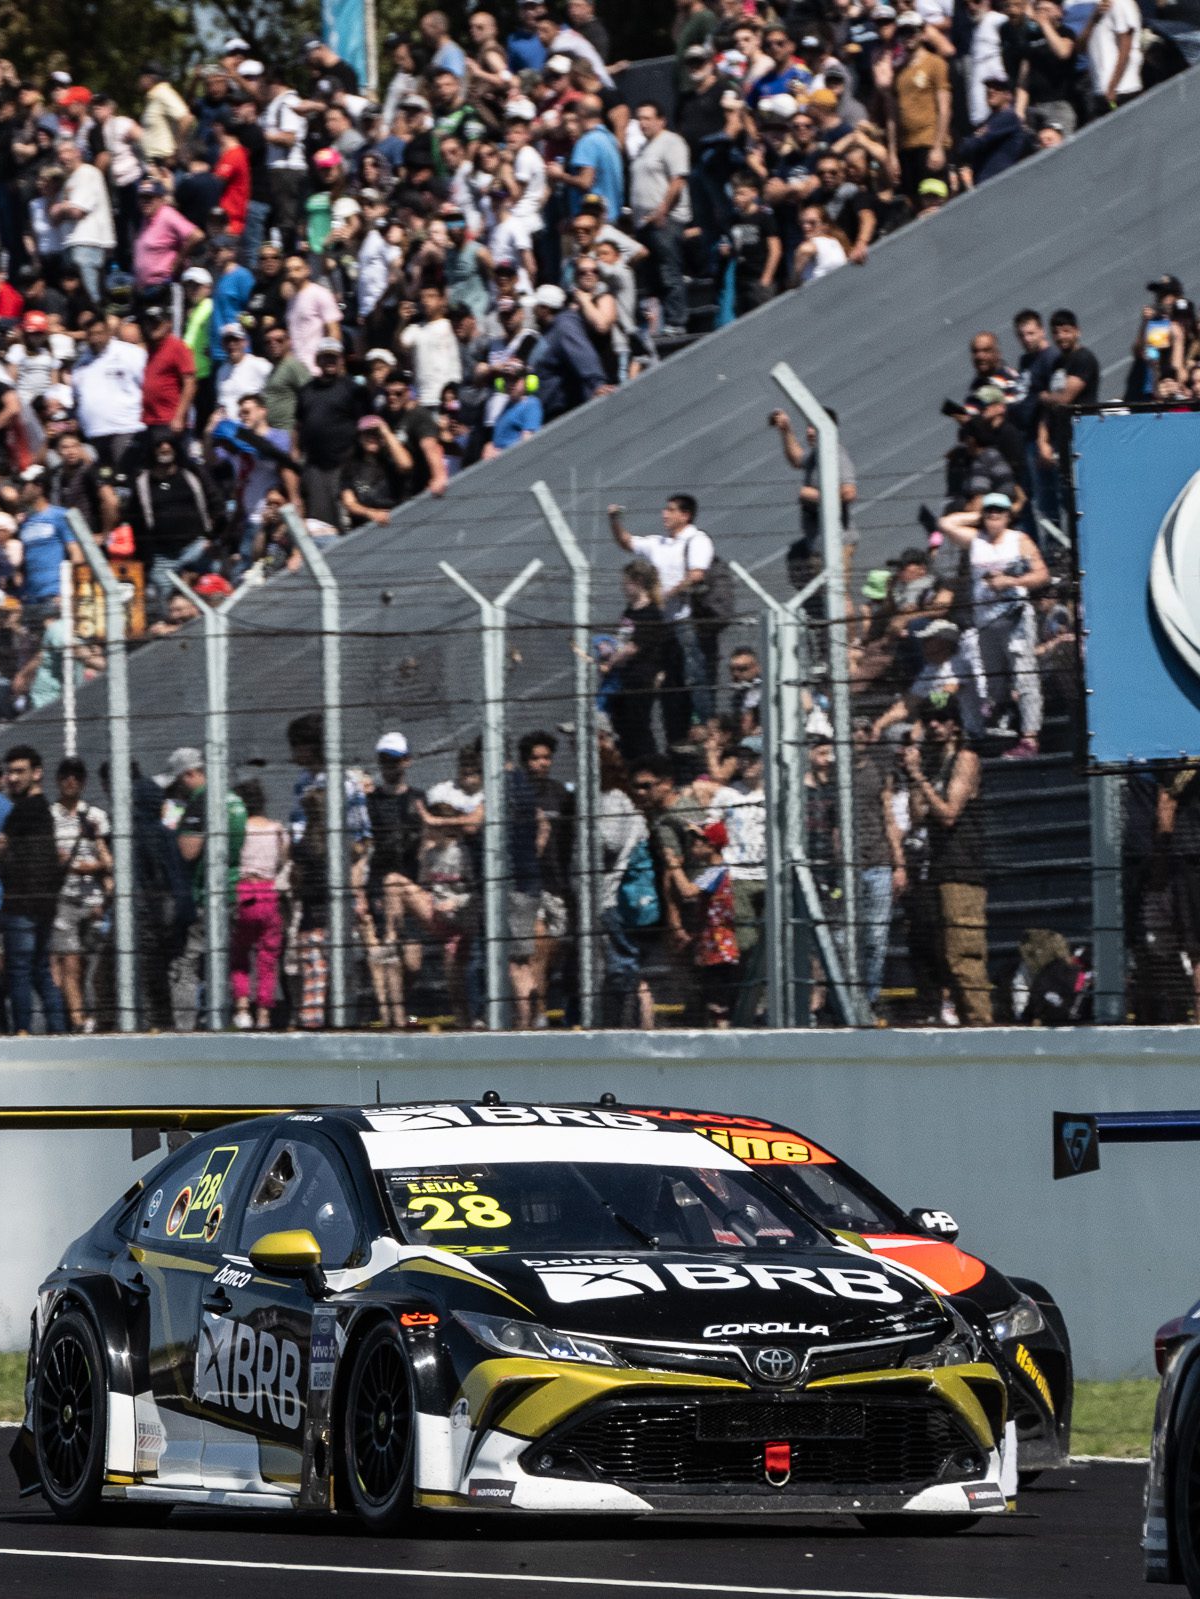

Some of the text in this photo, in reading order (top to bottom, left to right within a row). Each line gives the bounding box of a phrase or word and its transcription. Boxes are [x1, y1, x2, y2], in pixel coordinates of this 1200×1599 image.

[470, 1106, 660, 1131] BRB
[694, 1127, 810, 1162] ine
[190, 1173, 223, 1211] 28
[406, 1180, 479, 1194] E.ELIAS
[407, 1194, 512, 1231] 28
[212, 1263, 252, 1289] banco
[520, 1257, 640, 1268] banco
[661, 1262, 904, 1304] BRB
[702, 1321, 830, 1338] COROLLA
[232, 1322, 302, 1430] BRB
